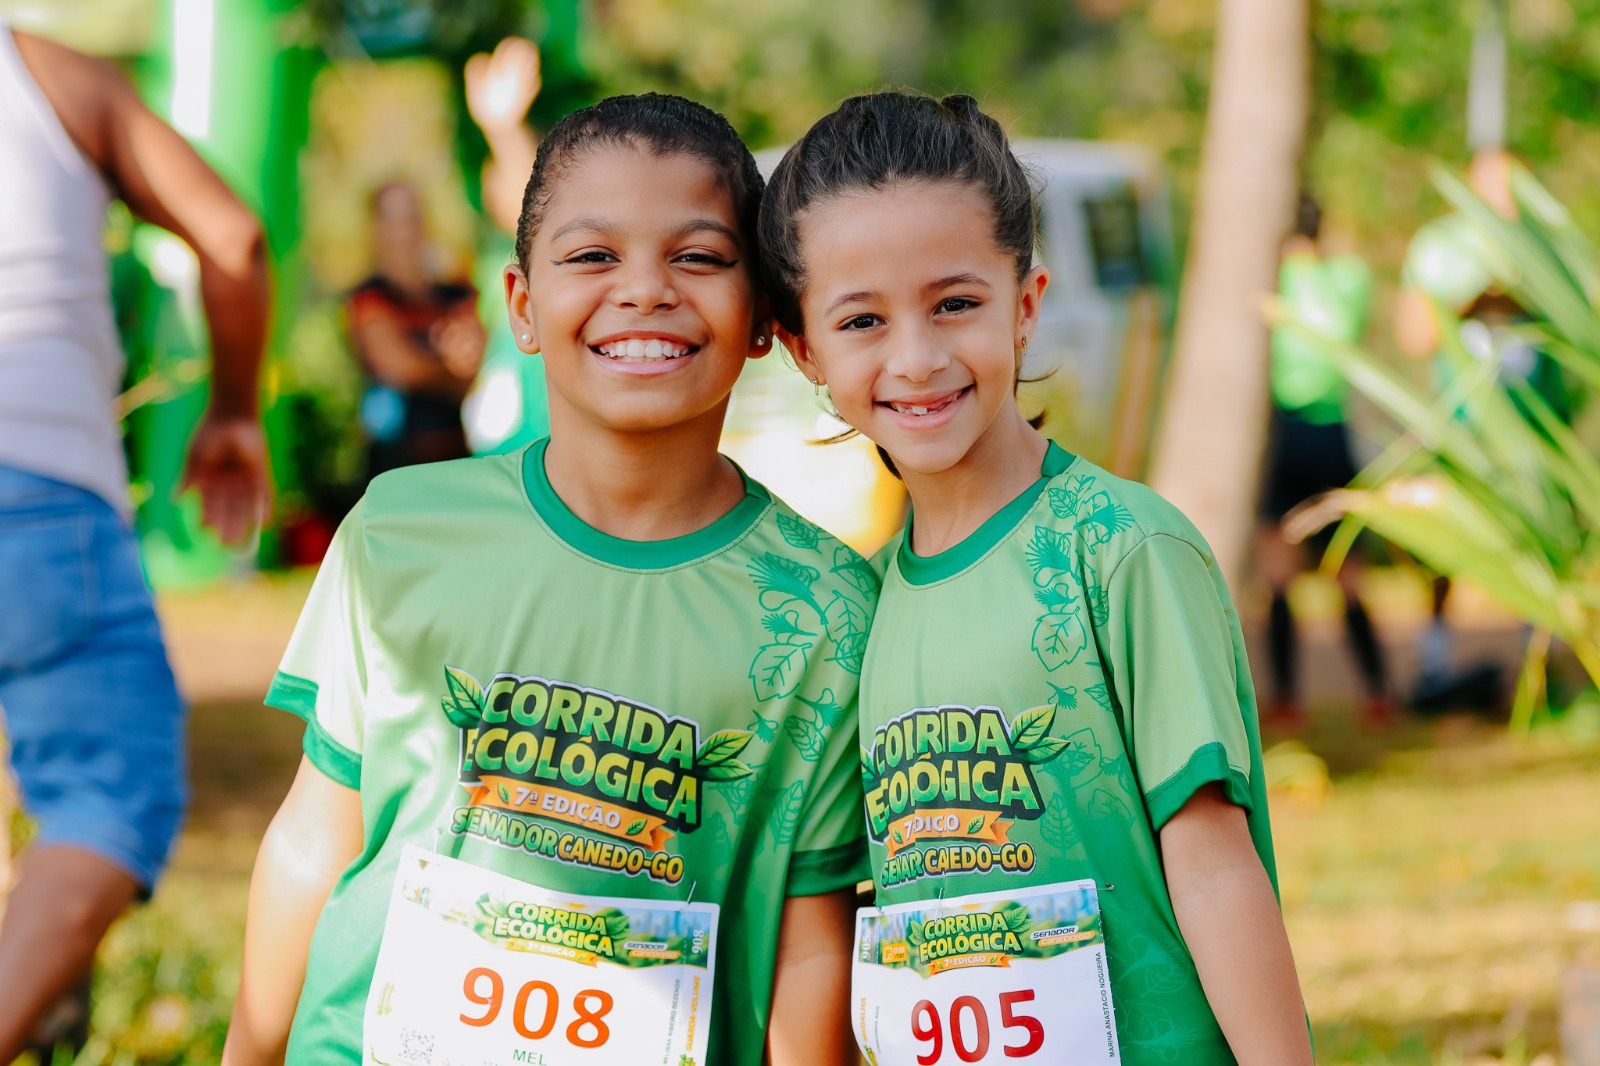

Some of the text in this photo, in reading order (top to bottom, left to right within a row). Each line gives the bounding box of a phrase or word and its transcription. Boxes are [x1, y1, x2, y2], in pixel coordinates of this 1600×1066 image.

[481, 680, 694, 770] CORRIDA
[463, 728, 697, 825] ECOLÓGICA
[541, 792, 621, 830] EDIÇÃO
[450, 806, 684, 884] SENADOR CANEDO-GO
[493, 916, 614, 957] ECOLÓGICA
[508, 901, 608, 936] CORRIDA
[924, 912, 1009, 940] CORRIDA
[691, 929, 704, 954] 908
[920, 932, 1022, 962] ECOLÓGICA
[459, 967, 614, 1048] 908
[1096, 951, 1115, 1058] MARINA ANASTACIO NOGUEIRA
[911, 988, 1044, 1066] 905
[512, 1049, 548, 1066] MEL
